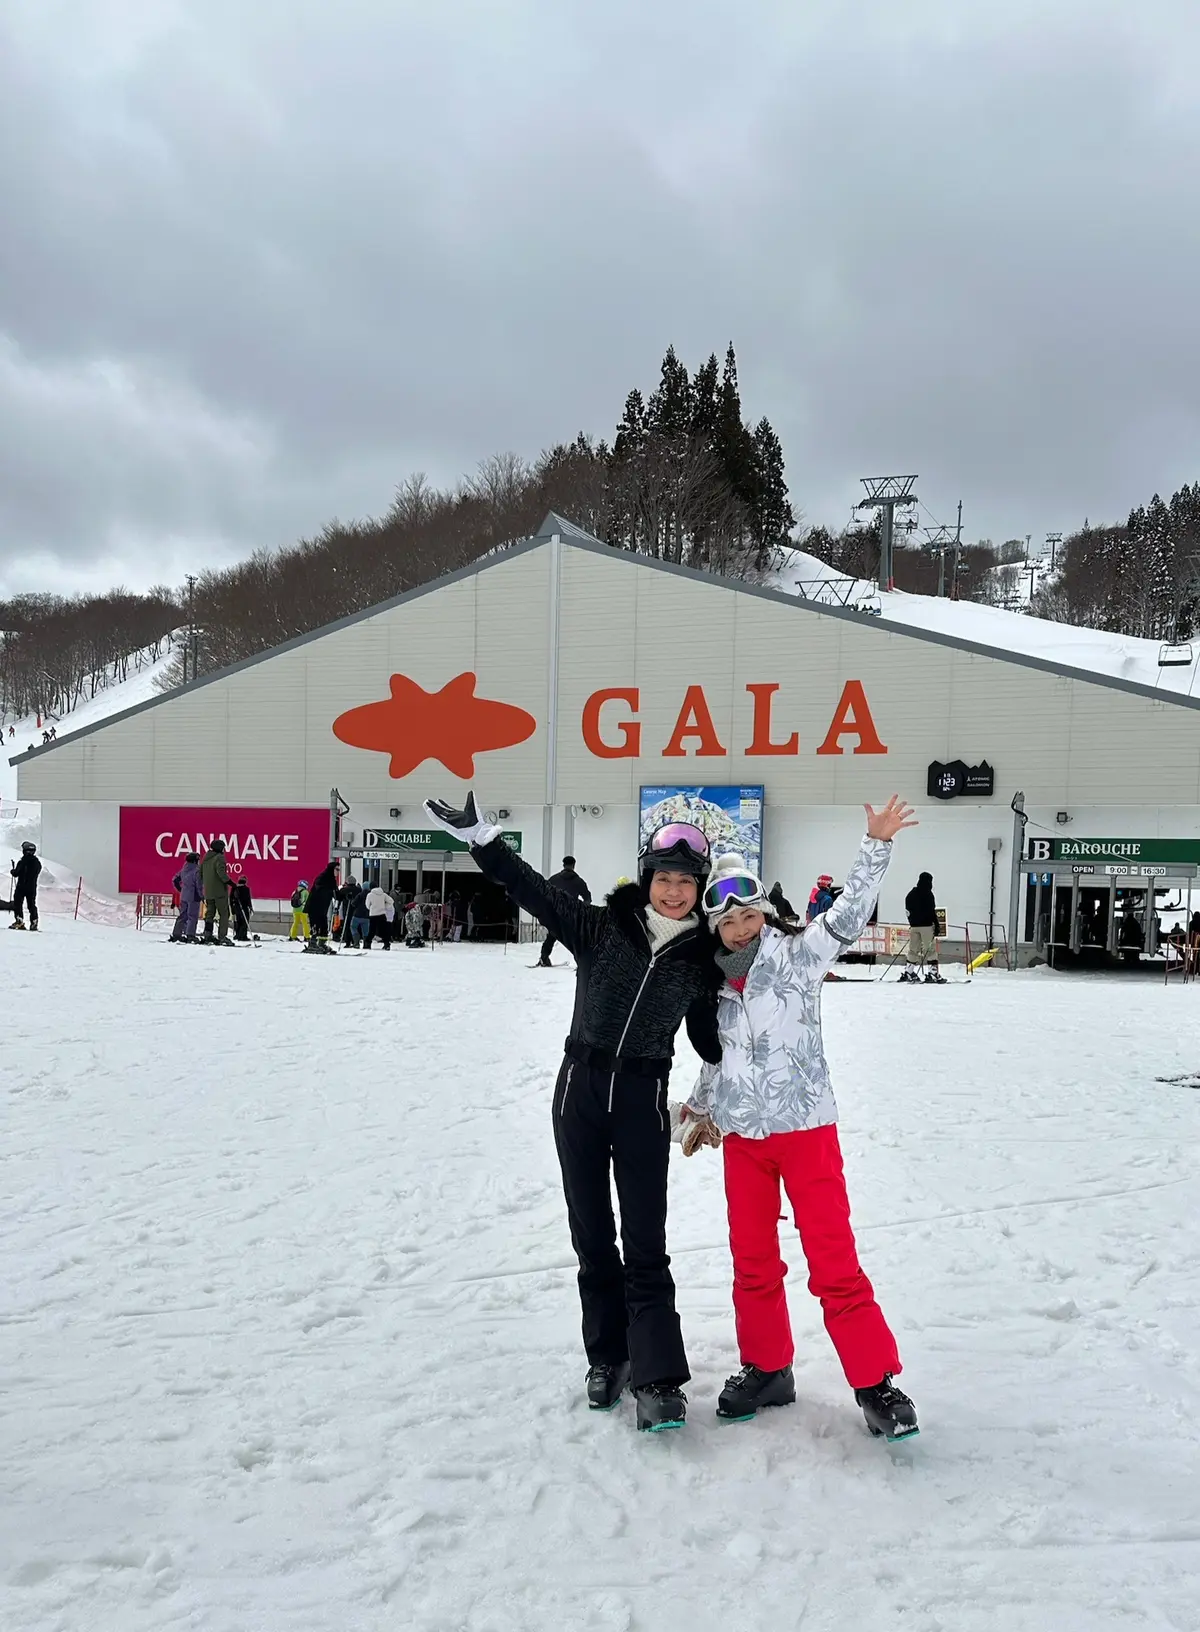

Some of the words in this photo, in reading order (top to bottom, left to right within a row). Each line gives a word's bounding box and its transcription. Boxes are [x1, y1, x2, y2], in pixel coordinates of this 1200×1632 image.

[581, 680, 888, 759] GALA
[155, 832, 299, 861] CANMAKE
[365, 831, 378, 848] D
[384, 833, 432, 844] SOCIABLE
[1032, 840, 1050, 860] B
[1060, 842, 1141, 855] BAROUCHE
